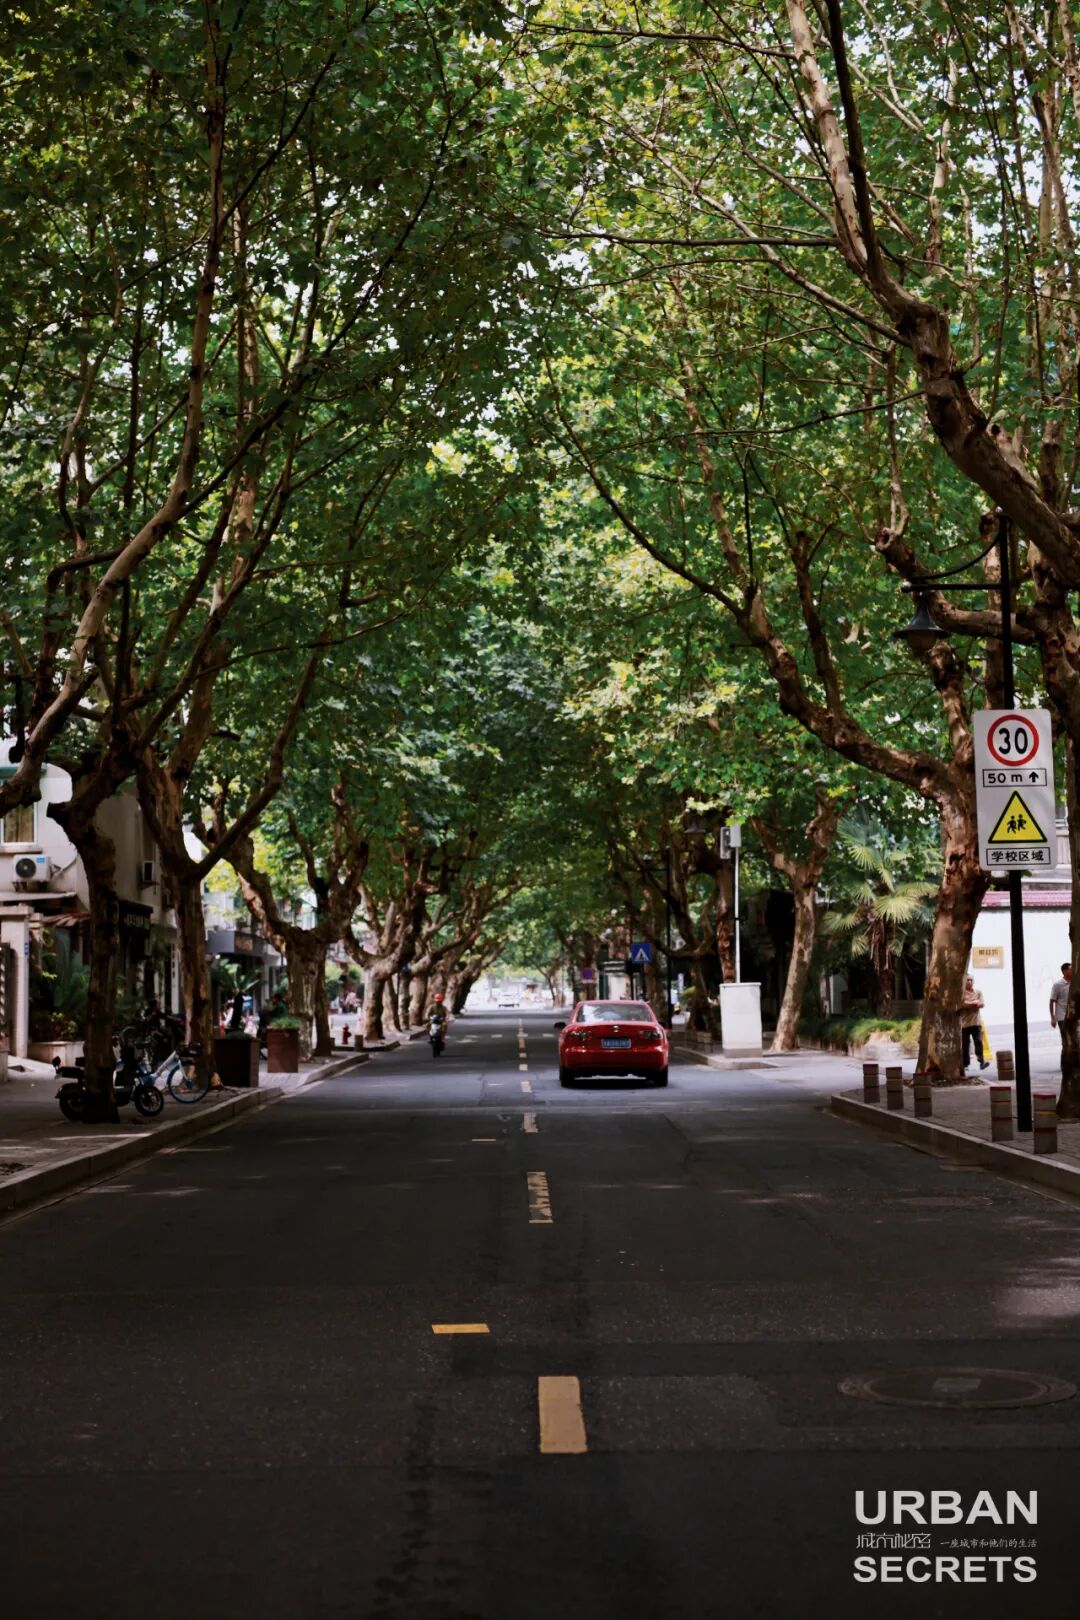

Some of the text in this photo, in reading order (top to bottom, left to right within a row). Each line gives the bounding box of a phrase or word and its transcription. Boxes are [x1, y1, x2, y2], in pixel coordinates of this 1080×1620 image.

[998, 727, 1029, 755] 30
[987, 773, 1023, 784] 50 m
[991, 850, 1045, 863] 学校区域
